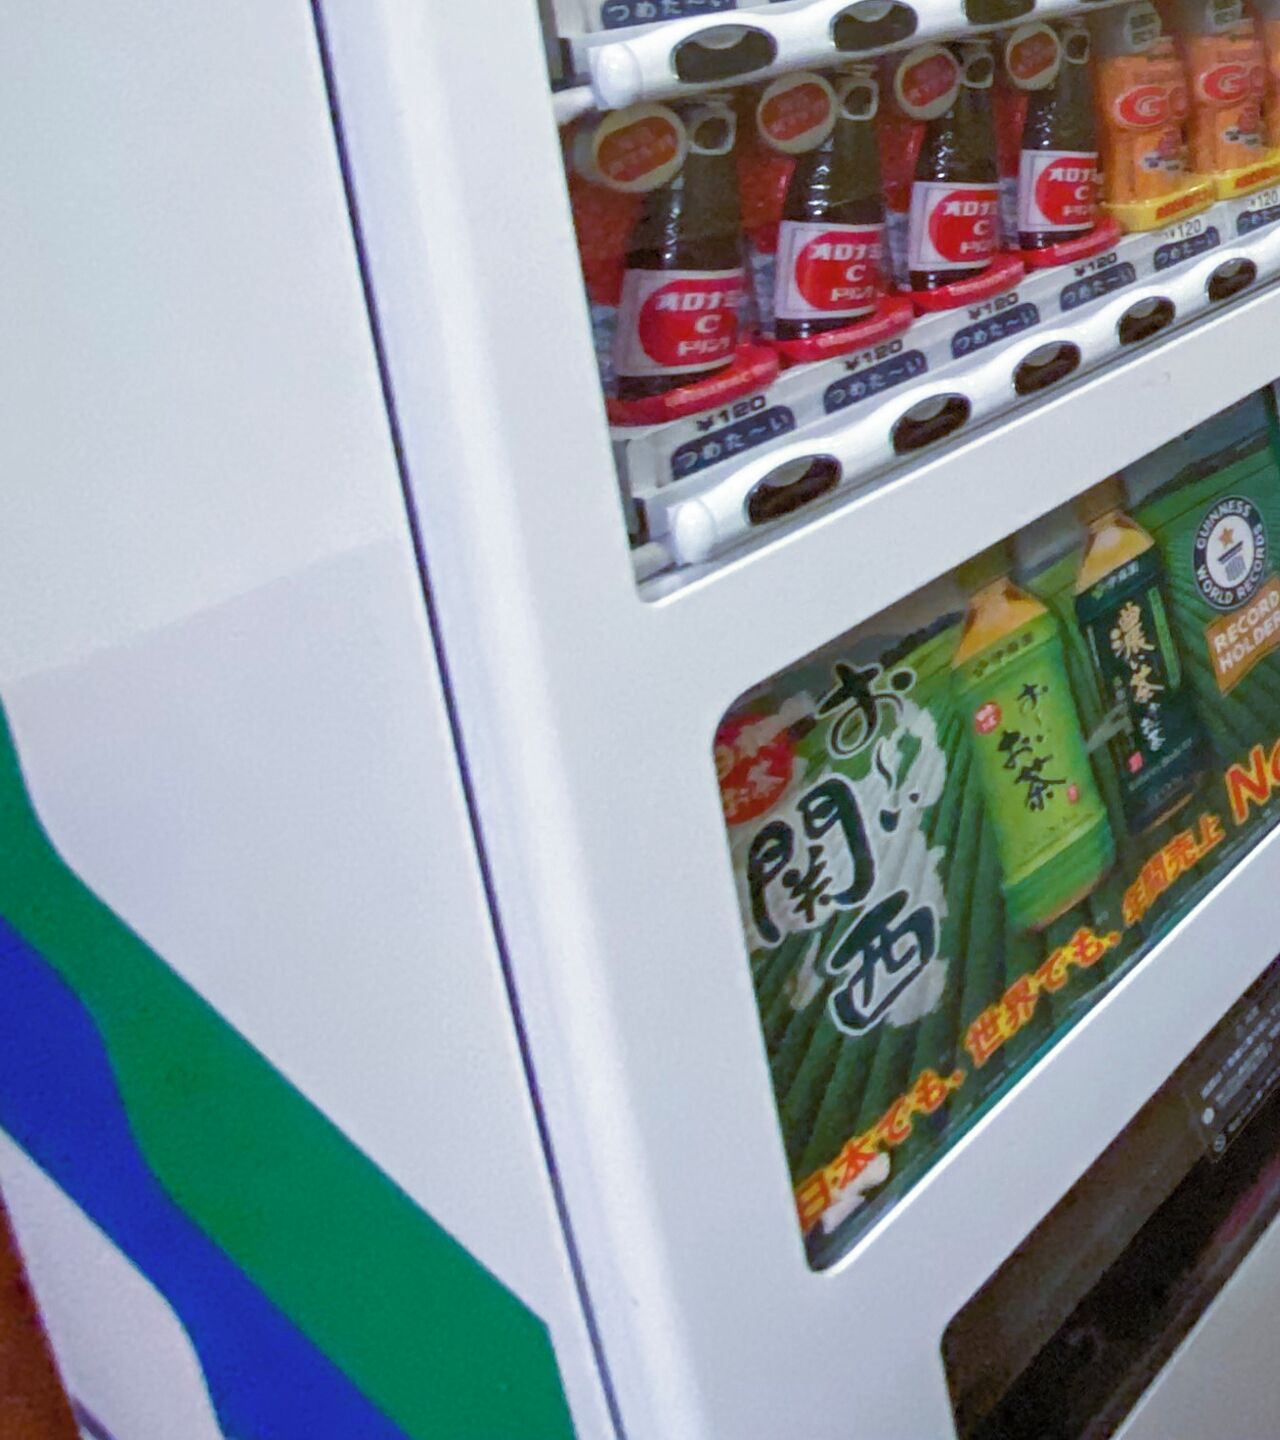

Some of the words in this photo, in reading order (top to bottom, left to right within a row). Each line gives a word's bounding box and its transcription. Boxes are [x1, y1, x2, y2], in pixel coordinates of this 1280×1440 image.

[1074, 186, 1088, 201] C
[973, 220, 990, 235] C
[845, 264, 867, 282] C
[694, 313, 722, 334] C
[968, 292, 1019, 320] ¥120
[954, 309, 1037, 352] つめた〜い
[844, 339, 904, 371] ¥120
[828, 357, 923, 405] つめた〜い
[695, 395, 767, 432] ¥120
[677, 413, 791, 468] つめた〜い
[1195, 498, 1252, 550] GUINNESS
[1195, 567, 1234, 606] WORLD
[1213, 589, 1280, 654] RECORD
